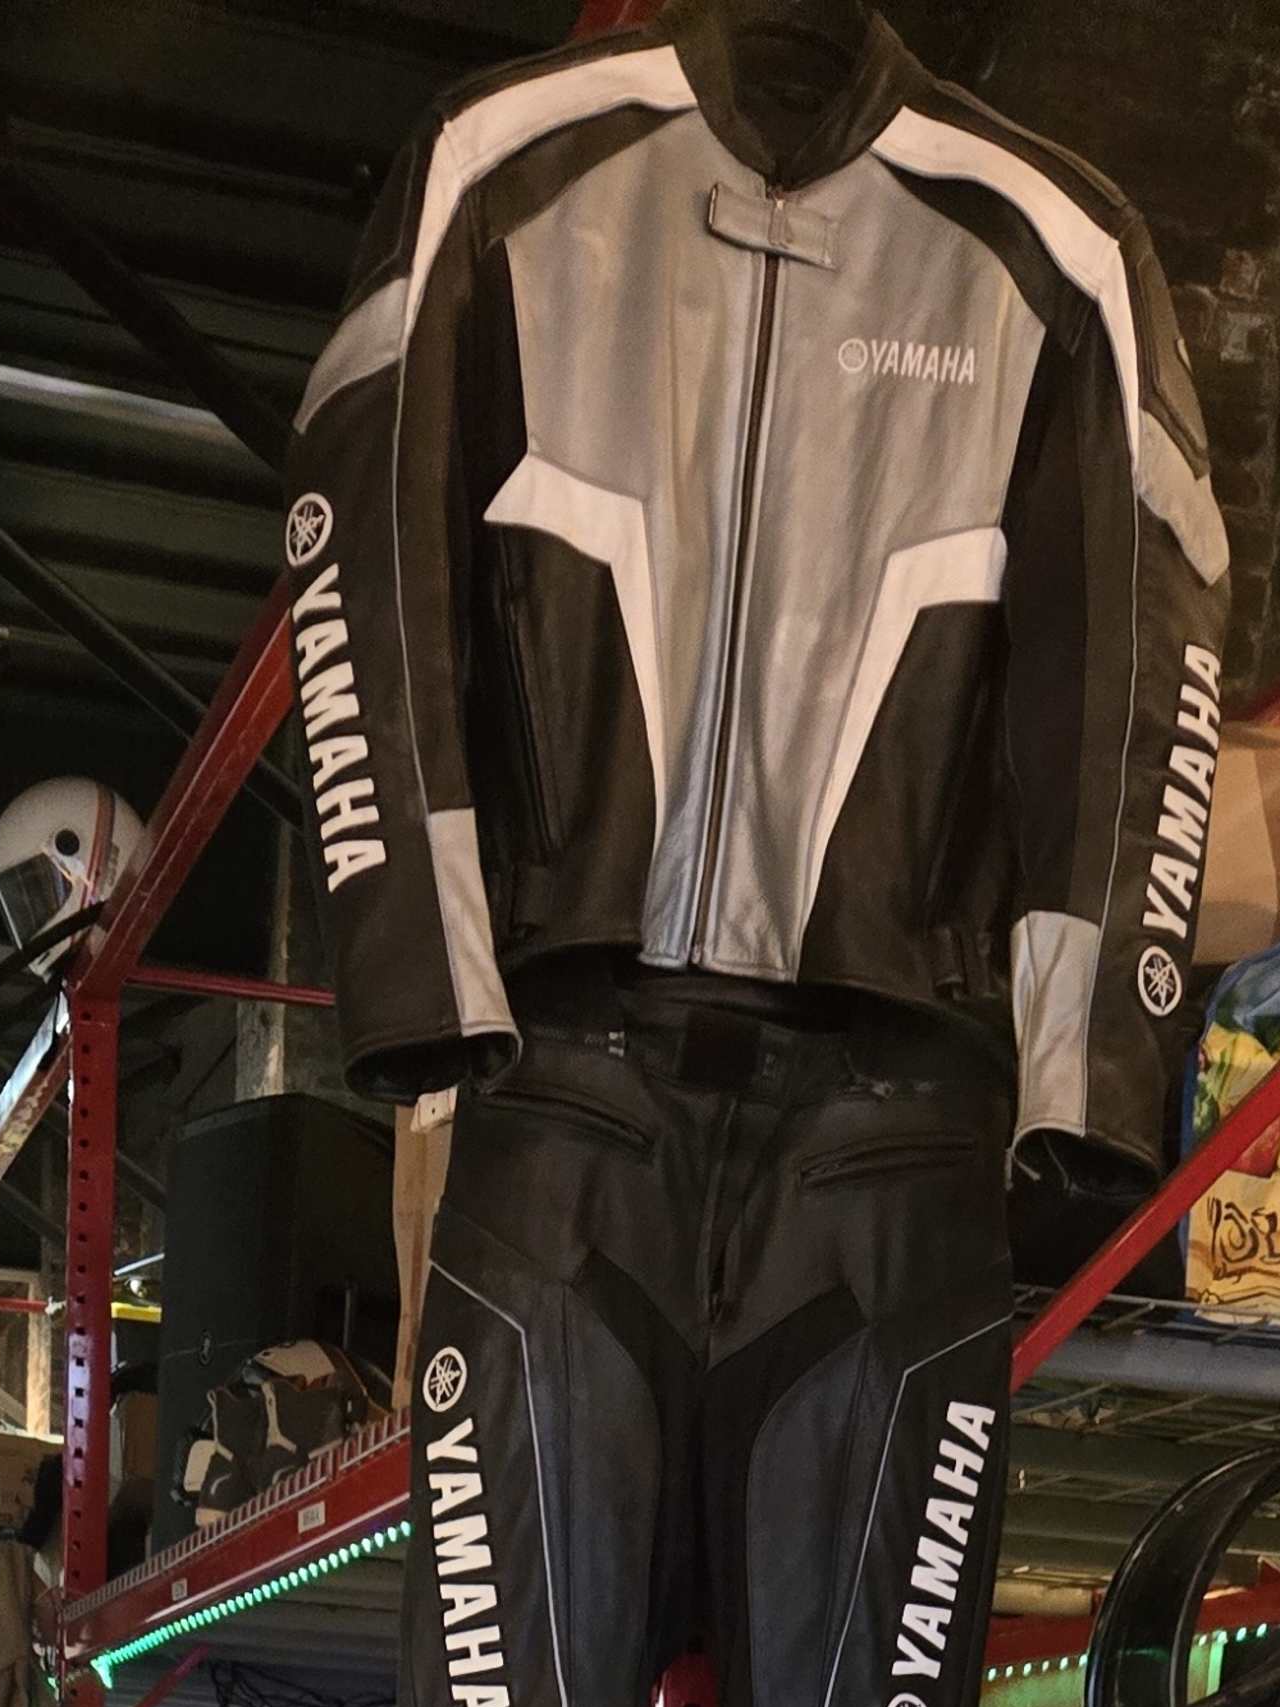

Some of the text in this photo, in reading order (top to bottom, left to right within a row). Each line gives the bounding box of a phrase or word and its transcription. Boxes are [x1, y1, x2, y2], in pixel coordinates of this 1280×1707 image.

[869, 337, 977, 385] YAMAHA
[291, 563, 386, 892] YAMAHA
[1142, 643, 1221, 942] YAMAHA
[891, 1400, 997, 1682] YAMAHA
